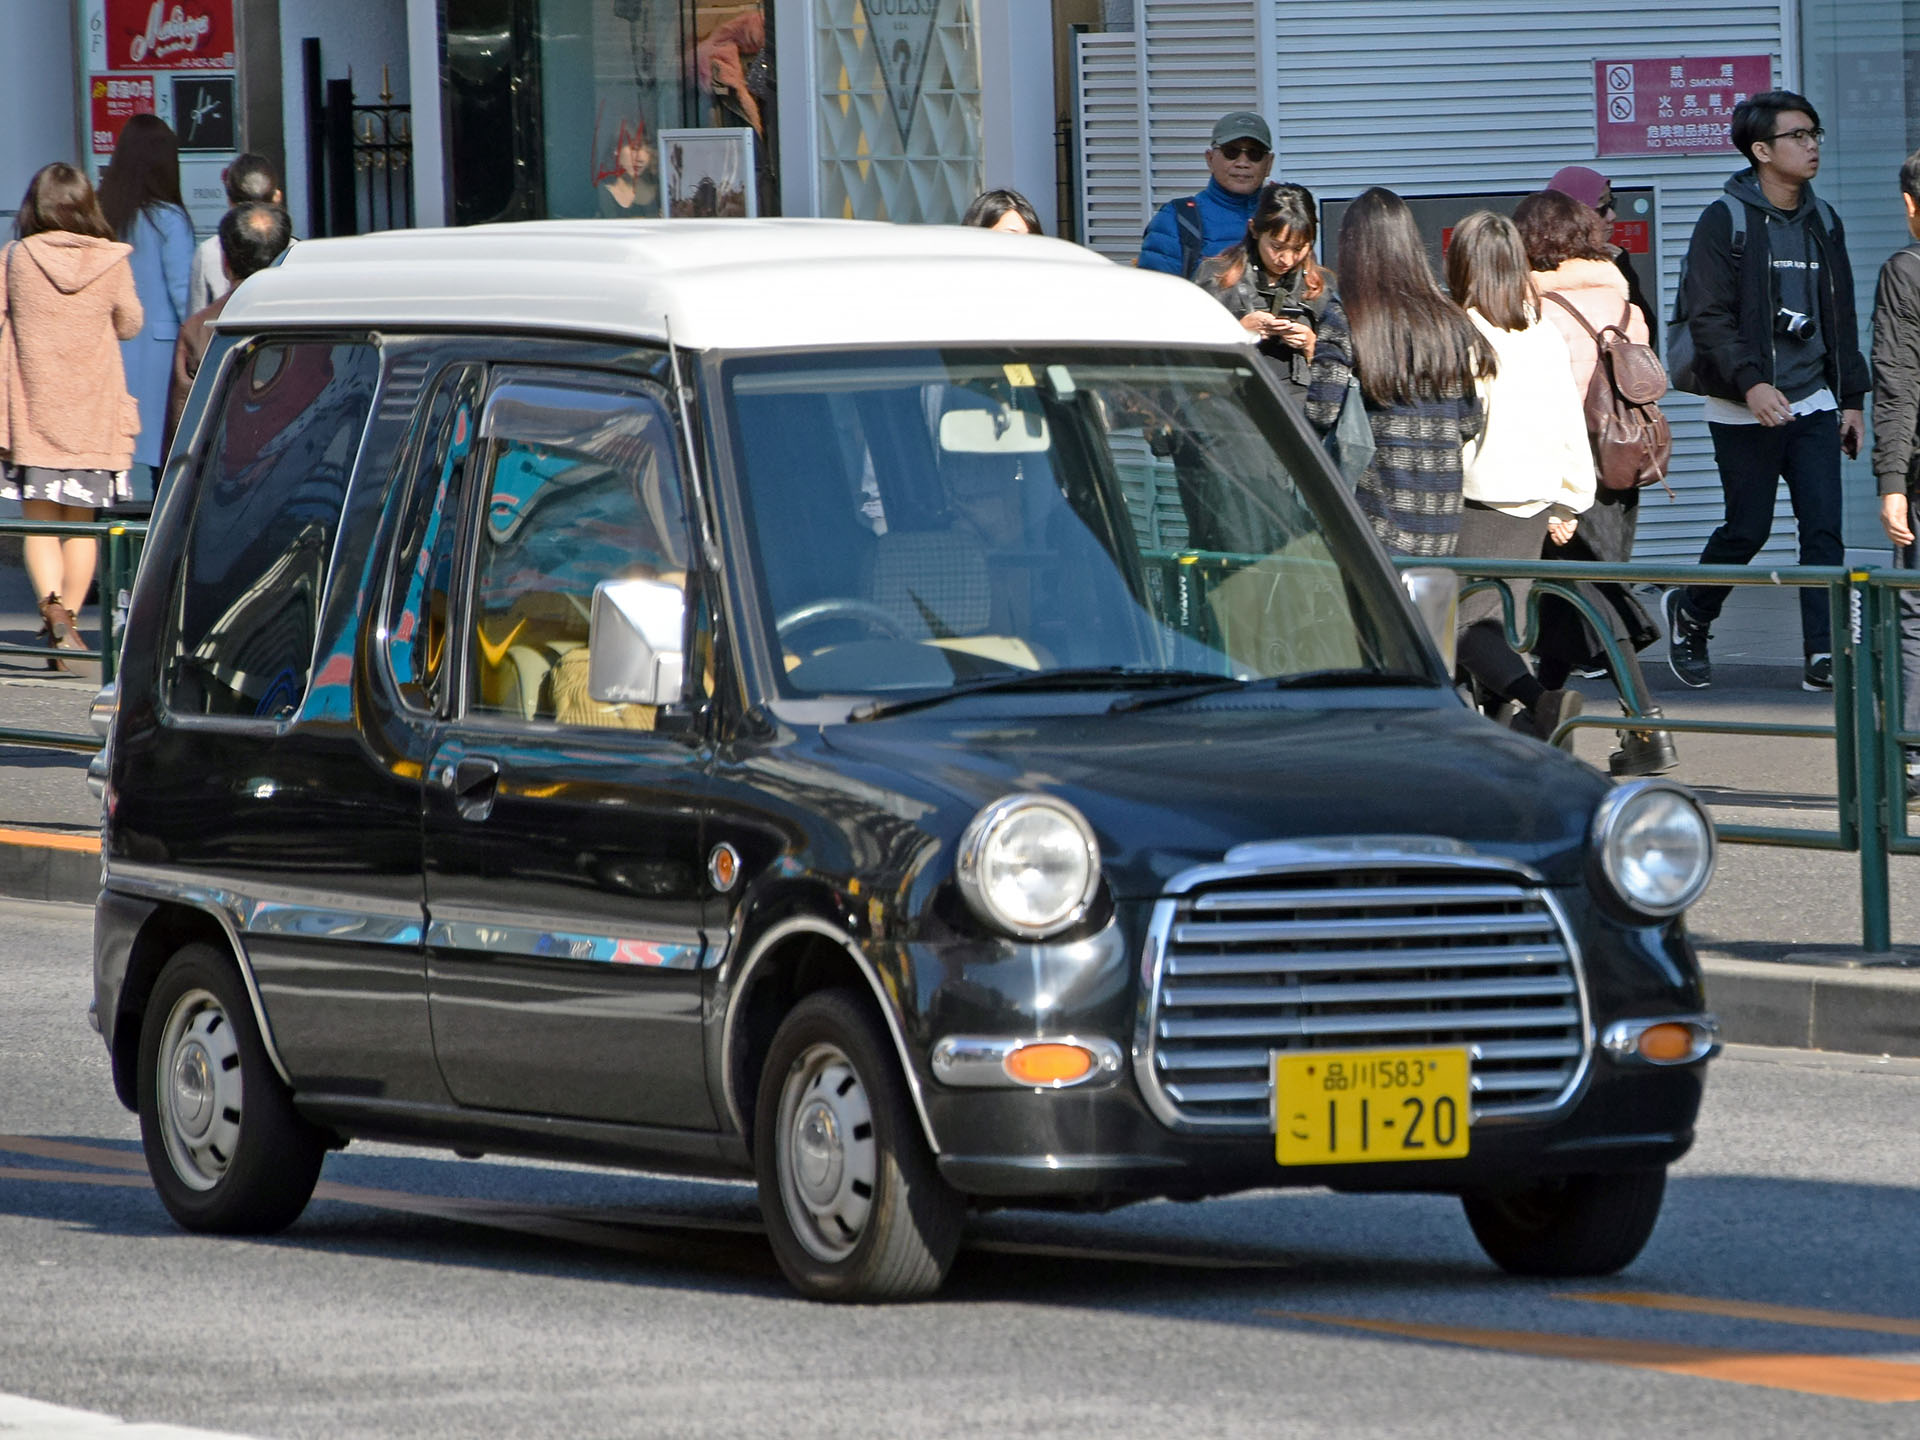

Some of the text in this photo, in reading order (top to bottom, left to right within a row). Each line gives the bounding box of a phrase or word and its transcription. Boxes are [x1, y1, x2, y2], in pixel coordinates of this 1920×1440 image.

[1670, 78, 1734, 88] NO SMOKING
[1658, 109, 1674, 118] NO
[1680, 107, 1708, 118] OPEN
[1647, 139, 1662, 148] NO
[1665, 137, 1723, 148] DANGEROUS
[1329, 1095, 1456, 1152] 11-20
